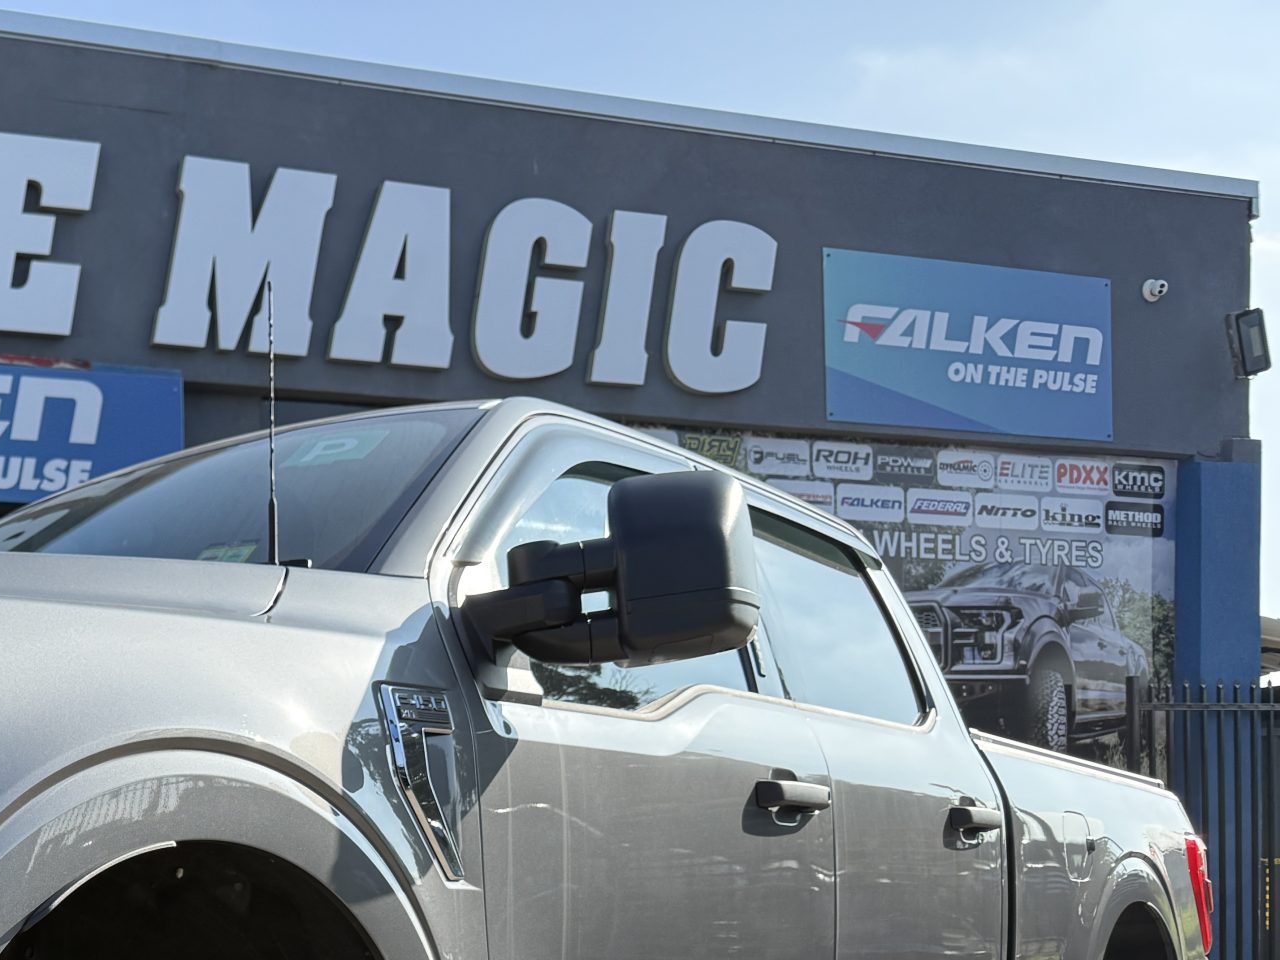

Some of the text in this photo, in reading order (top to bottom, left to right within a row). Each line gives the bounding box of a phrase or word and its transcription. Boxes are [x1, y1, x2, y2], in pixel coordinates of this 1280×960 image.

[152, 155, 778, 393] MAGIC
[843, 304, 1103, 365] FALKEN
[947, 362, 1098, 393] ON THE PULSE
[300, 437, 359, 462] P
[815, 449, 870, 466] ROH
[826, 465, 860, 473] WHEELS
[999, 461, 1050, 480] ELITE
[1057, 463, 1108, 486] PDXX
[1117, 484, 1161, 493] WHEELS
[841, 496, 902, 510] FALKEN
[914, 500, 969, 513] FEDERAL
[1108, 510, 1161, 523] METHOD
[873, 530, 1104, 568] WHEELS & TYRES
